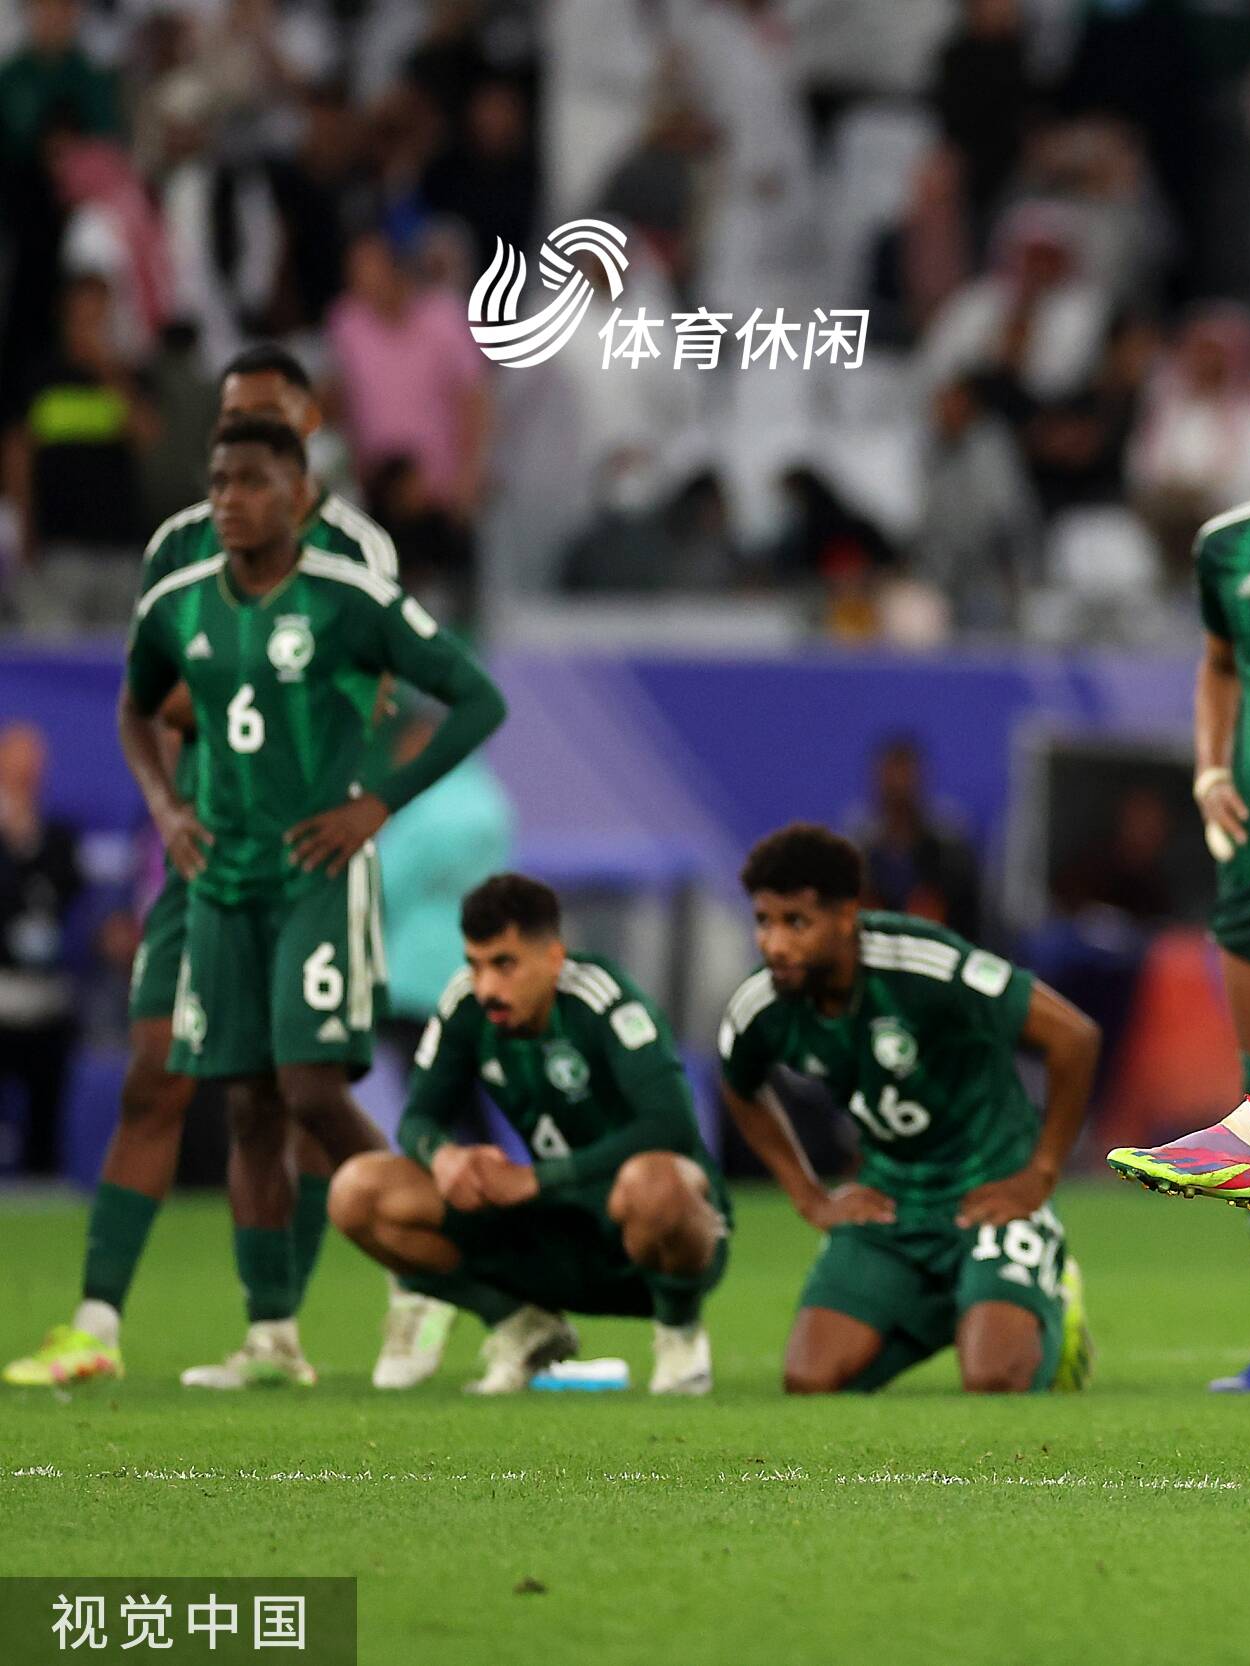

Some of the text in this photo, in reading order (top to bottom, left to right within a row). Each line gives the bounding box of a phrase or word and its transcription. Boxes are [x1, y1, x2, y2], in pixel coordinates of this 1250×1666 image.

[227, 683, 266, 754] 6
[303, 942, 344, 1011] 6
[532, 1114, 571, 1159] 4
[849, 1085, 930, 1140] 16
[972, 1218, 1045, 1268] 16
